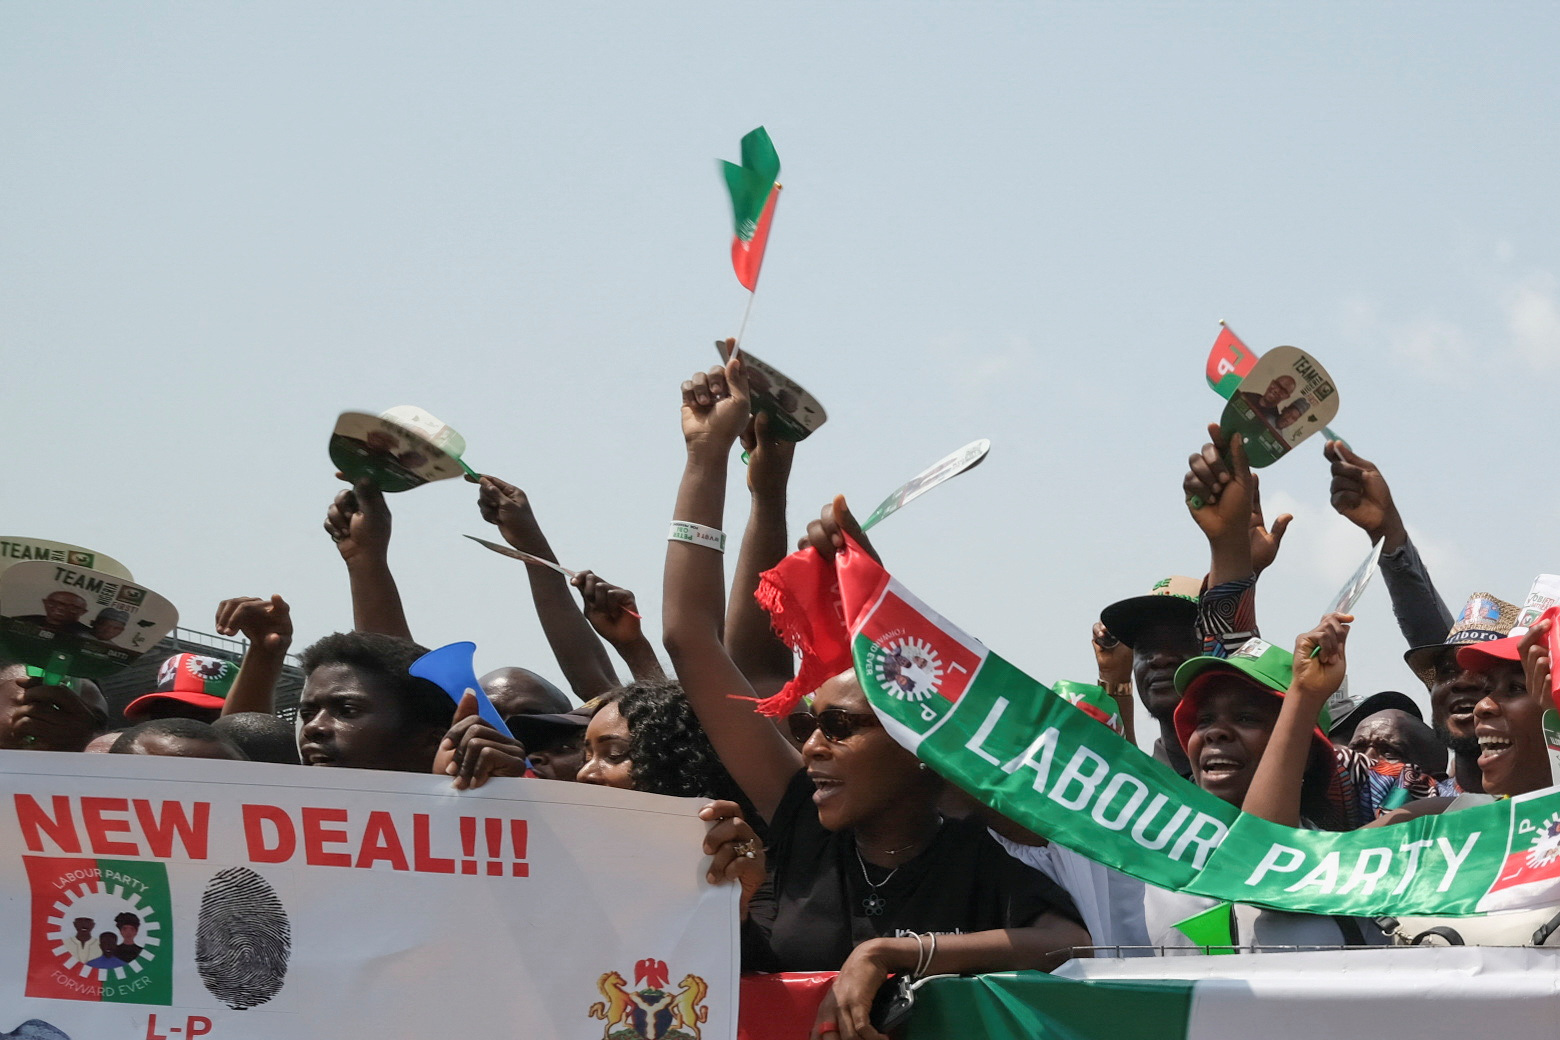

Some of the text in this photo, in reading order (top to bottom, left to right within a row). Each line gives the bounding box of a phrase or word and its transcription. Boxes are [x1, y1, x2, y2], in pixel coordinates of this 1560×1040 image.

[1293, 355, 1318, 382] TEAM
[1, 541, 51, 560] TEAM
[55, 567, 101, 593] TEAM
[963, 696, 1481, 896] LABOUR PARTY
[13, 793, 530, 878] NEW DEAL!!!
[52, 868, 149, 892] LABOUR PARTY
[50, 970, 152, 997] FORWARD EVER
